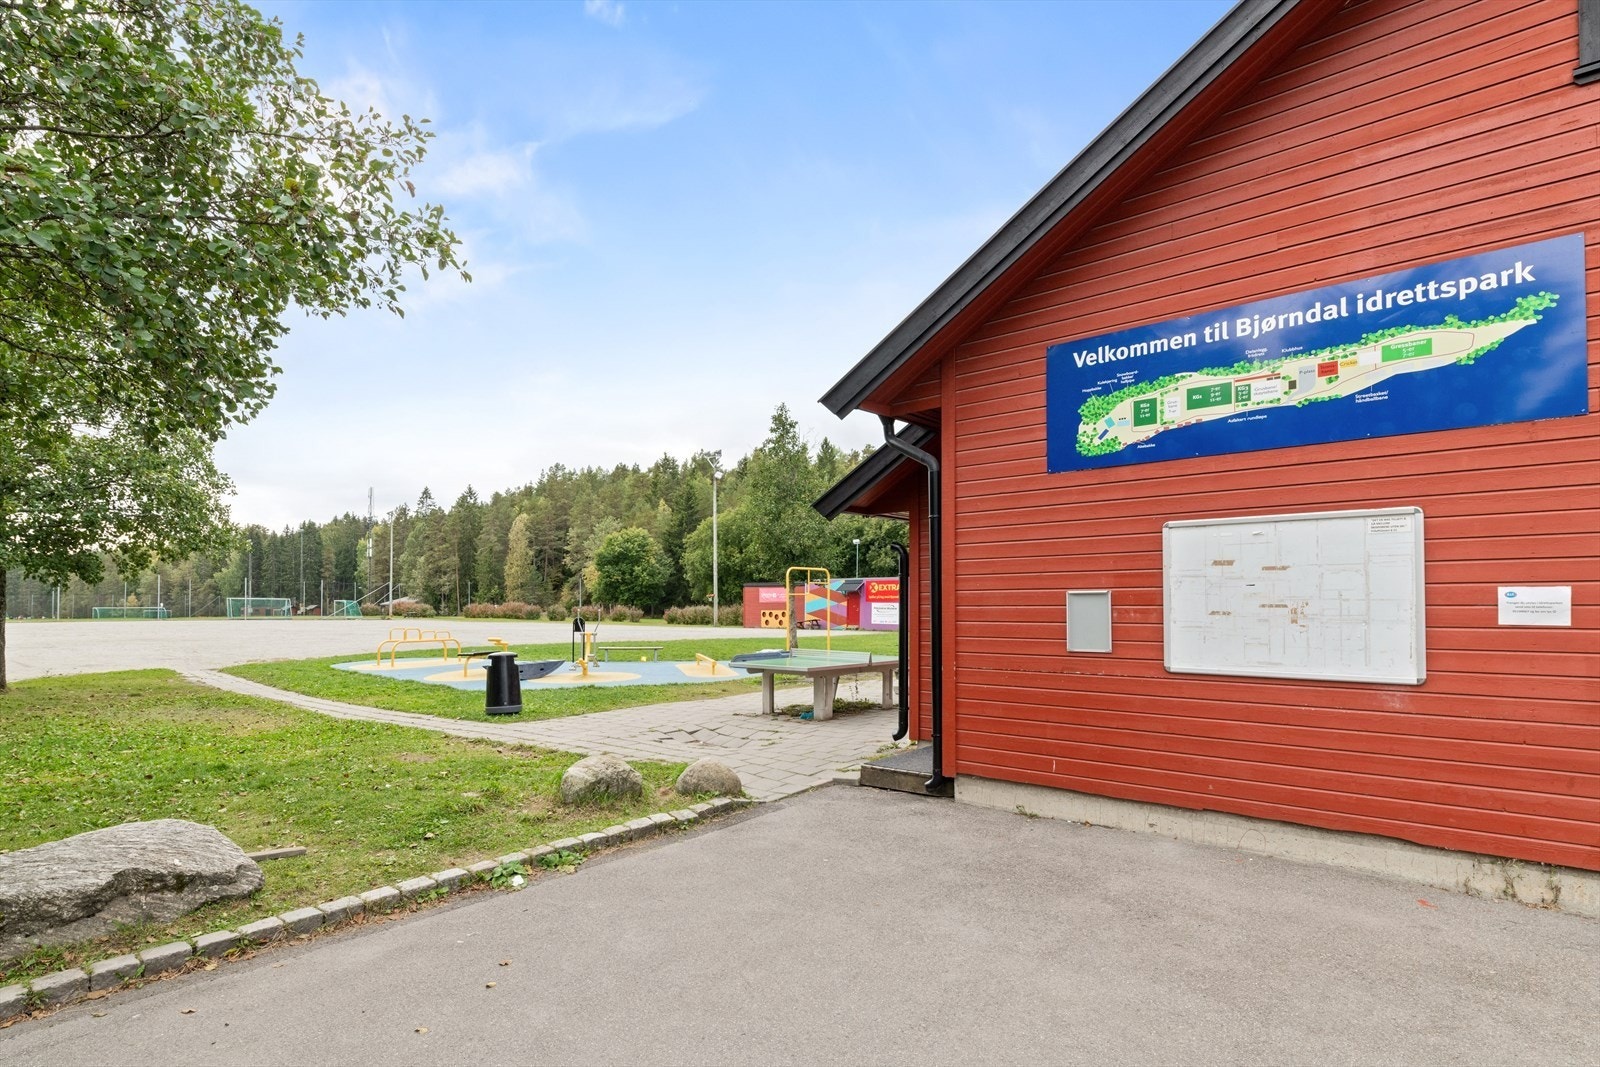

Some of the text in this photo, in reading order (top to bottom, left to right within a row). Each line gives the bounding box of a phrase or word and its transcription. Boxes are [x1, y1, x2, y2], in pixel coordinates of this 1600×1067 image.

[1073, 261, 1537, 368] Velkommen til Bjørndal idrettspark
[1390, 339, 1427, 350] Gressbaner
[879, 583, 900, 591] EXTRA
